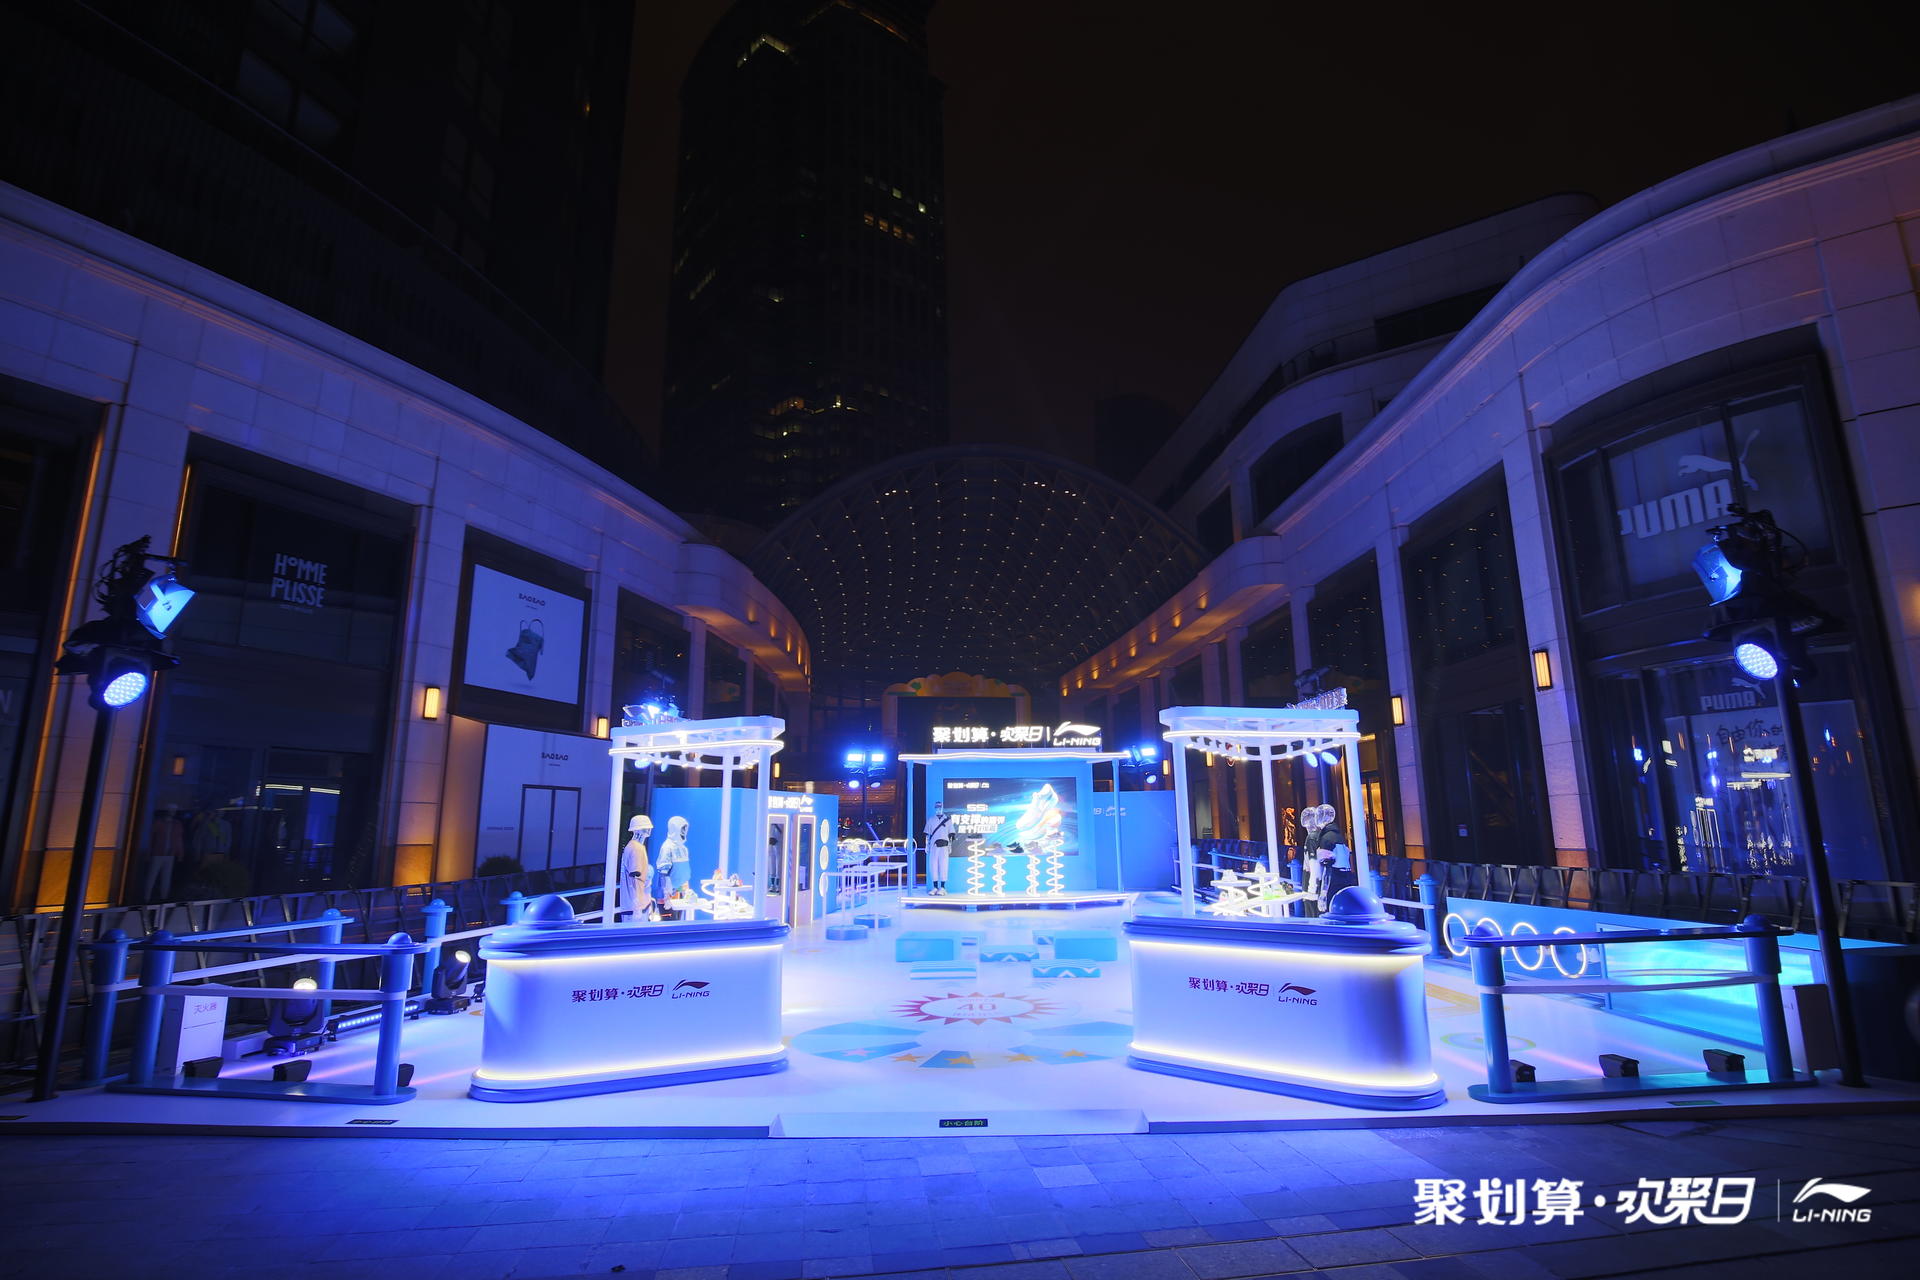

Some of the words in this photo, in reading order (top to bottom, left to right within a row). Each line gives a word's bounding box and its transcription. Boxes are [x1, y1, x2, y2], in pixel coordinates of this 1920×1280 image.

[1700, 690, 1756, 712] PUMA
[1053, 737, 1102, 747] LI-NING
[571, 984, 665, 1003] 聚划算·欢聚日
[671, 990, 711, 1000] LI-NING
[1188, 976, 1270, 997] 聚划算·欢聚日
[1278, 996, 1319, 1007] LI-NING
